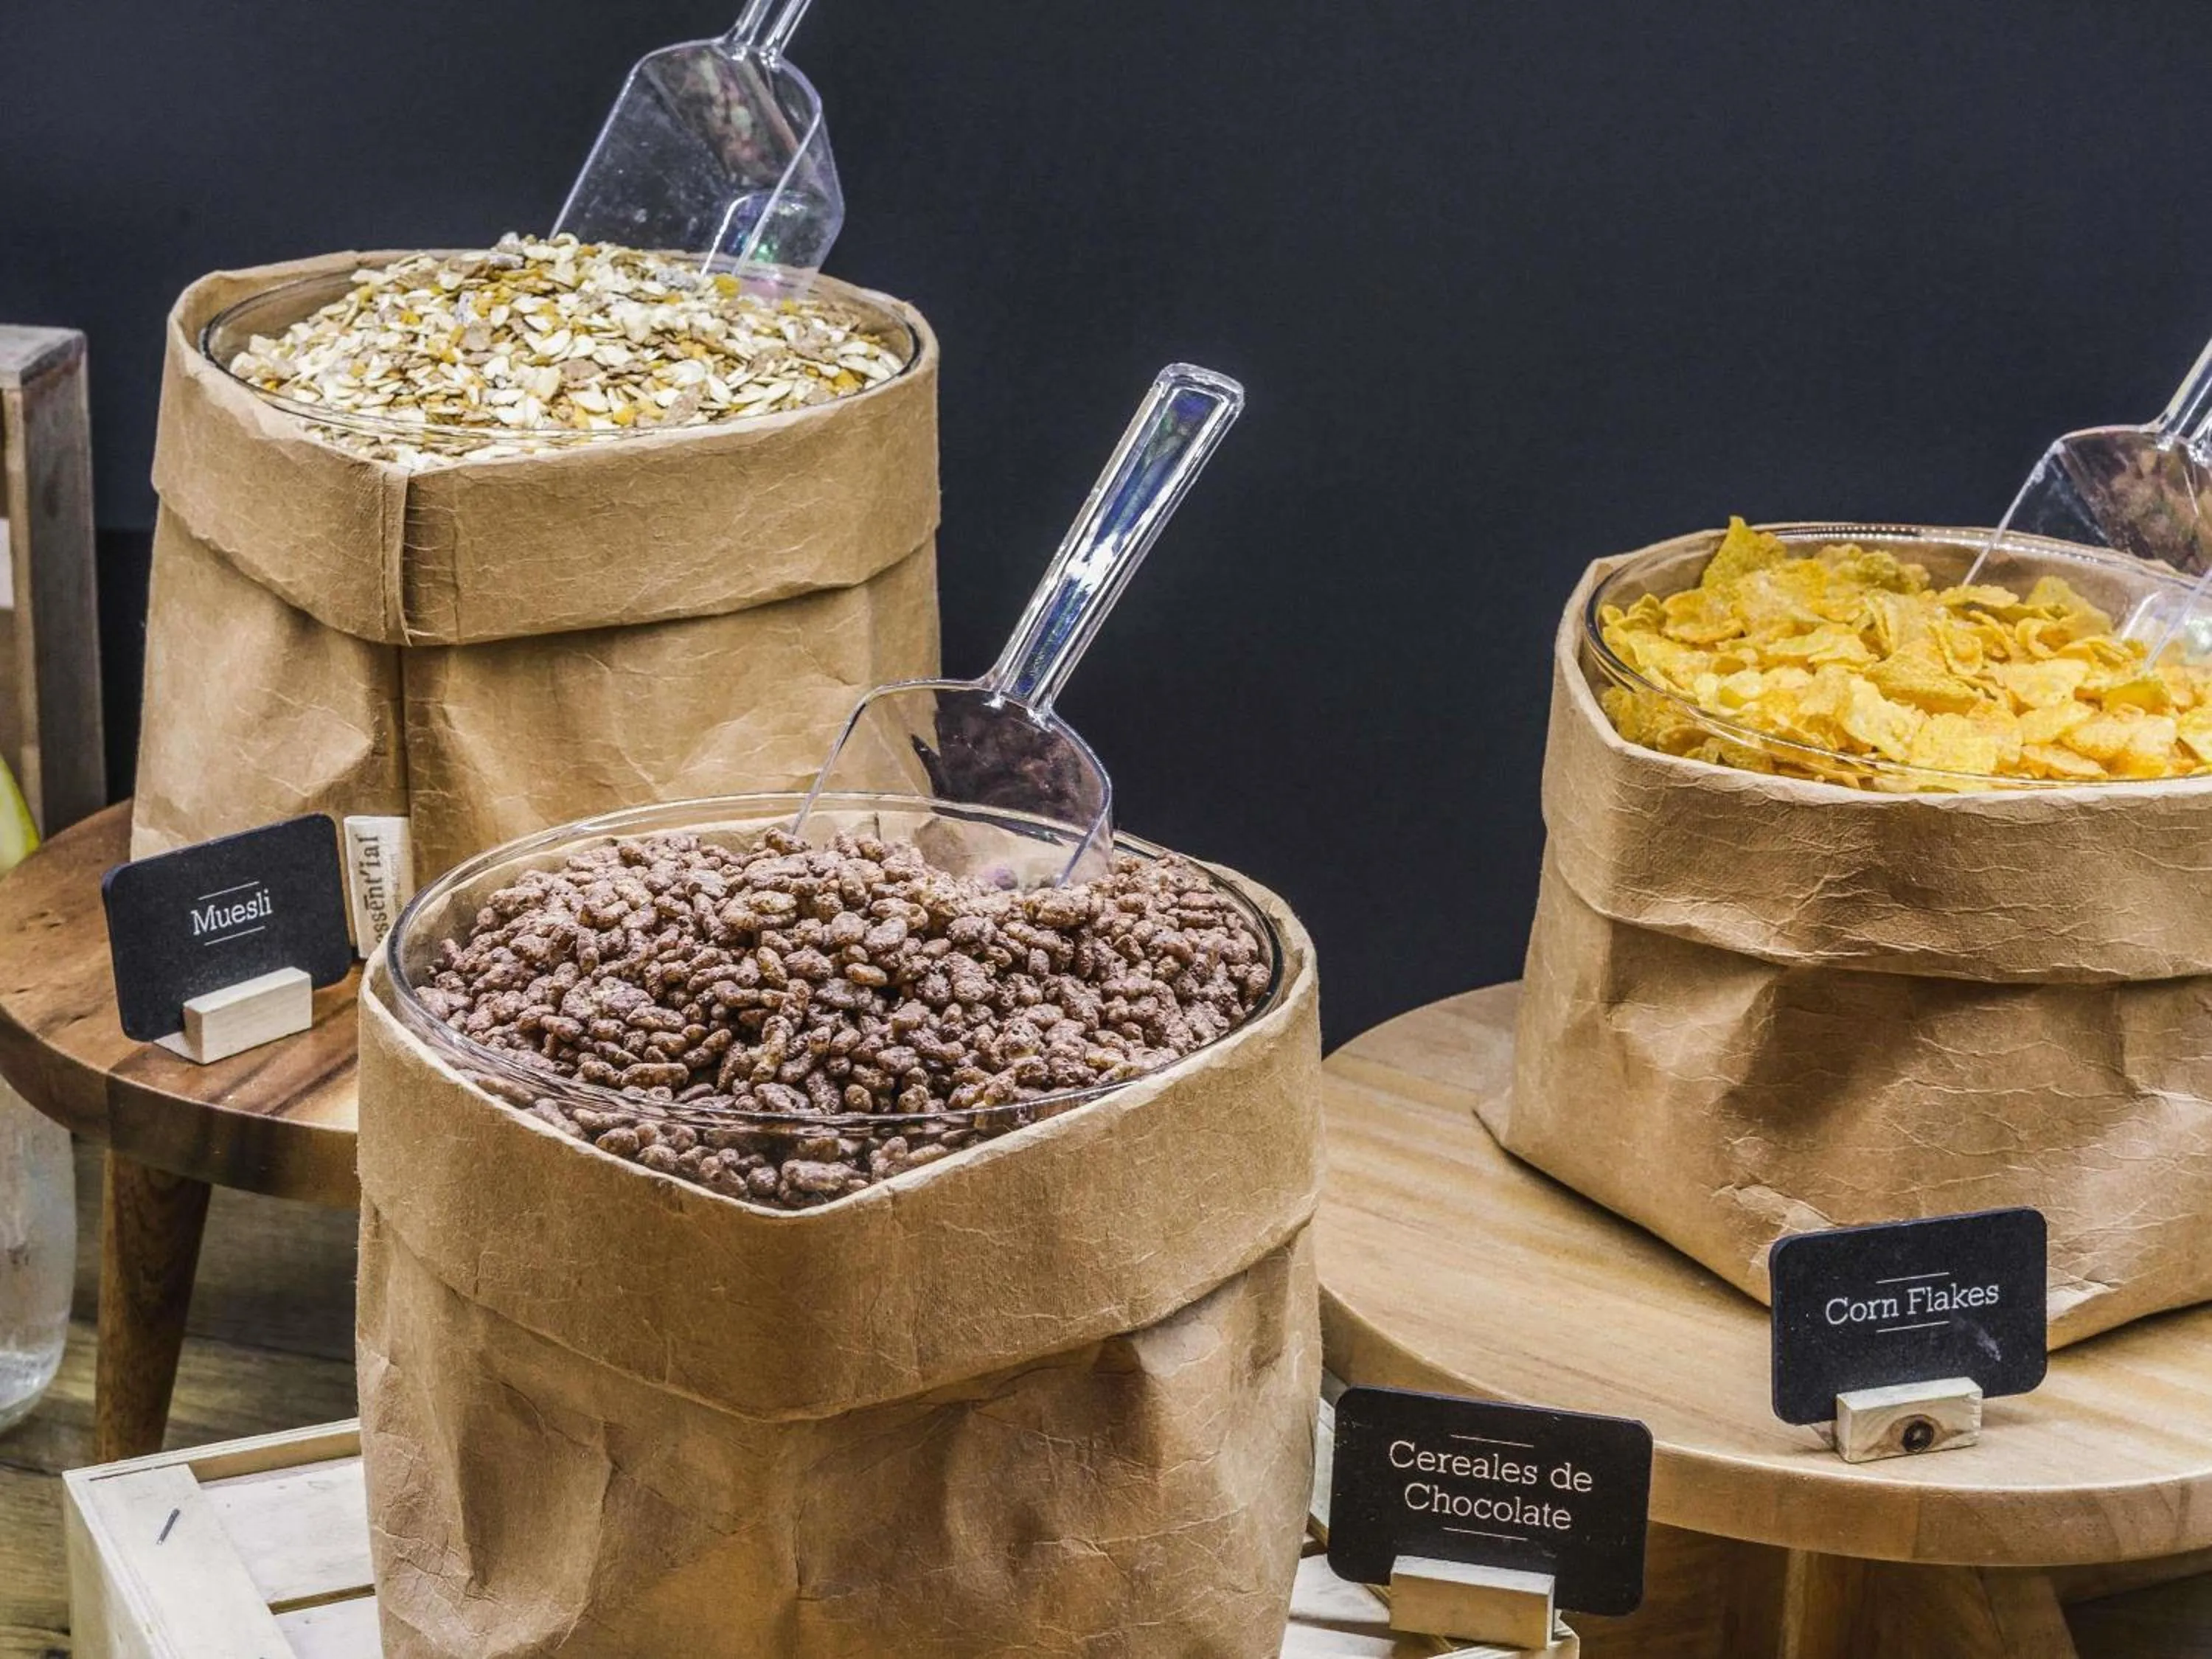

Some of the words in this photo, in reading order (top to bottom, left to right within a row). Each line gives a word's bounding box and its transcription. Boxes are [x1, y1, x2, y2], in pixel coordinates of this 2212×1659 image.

[189, 888, 274, 936] Muesli
[1825, 1296, 1900, 1326] Corn
[1907, 1282, 2000, 1315] Flakes
[1388, 1439, 1538, 1486] Cereales
[1549, 1461, 1593, 1493] de
[1404, 1482, 1572, 1531] Chocolate
